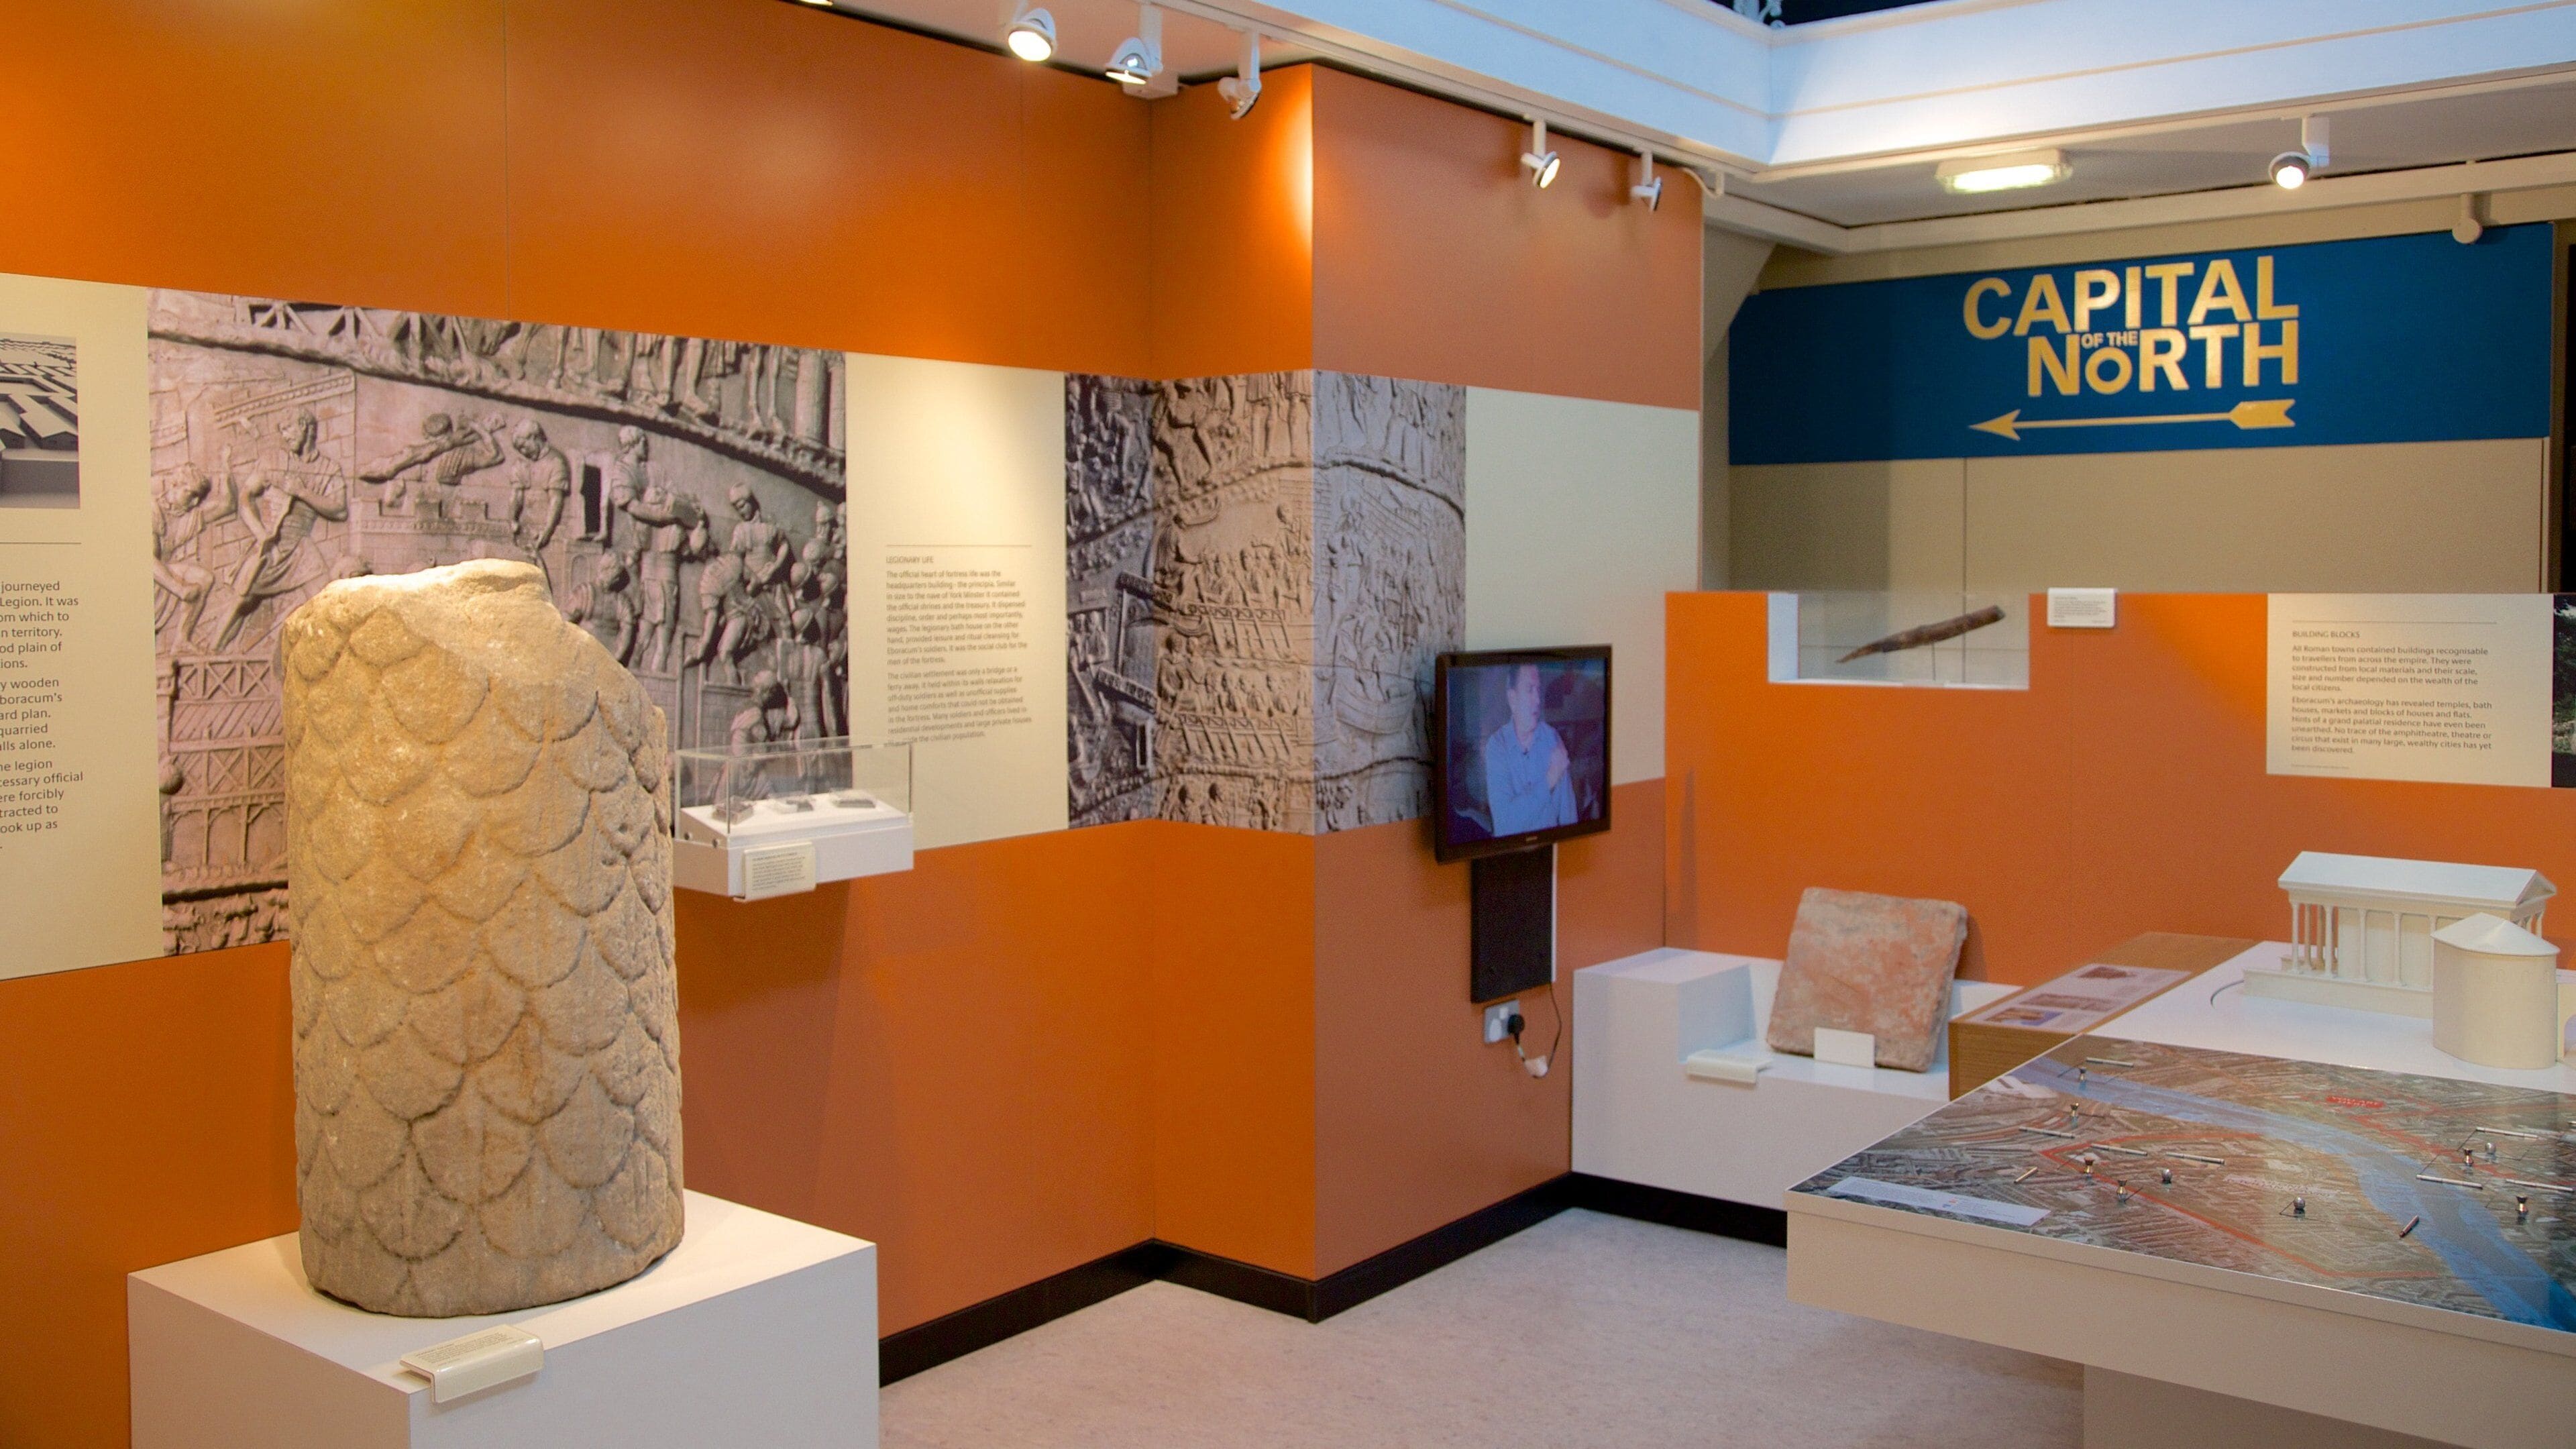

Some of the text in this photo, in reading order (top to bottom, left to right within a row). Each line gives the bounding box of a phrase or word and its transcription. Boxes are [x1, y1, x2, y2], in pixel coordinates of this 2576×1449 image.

[1963, 256, 2300, 340] CAPITAL
[2081, 330, 2138, 350] OF THE
[2027, 320, 2299, 397] NORTH
[1, 581, 60, 594] journeyed
[0, 597, 79, 609] Legion. It was
[19, 611, 54, 622] which
[58, 613, 70, 621] to
[12, 627, 62, 639] territory.
[18, 642, 47, 655] plain
[50, 641, 62, 651] of
[2436, 648, 2488, 656] recognisable
[11, 678, 59, 689] wooden
[2337, 698, 2383, 706] archaeology
[21, 709, 51, 721] plan.
[19, 739, 56, 749] alone.
[15, 759, 53, 772] legion
[43, 771, 83, 784] official
[19, 788, 64, 801] forcibly
[46, 805, 58, 814] to
[26, 822, 42, 832] up
[46, 821, 58, 829] as
